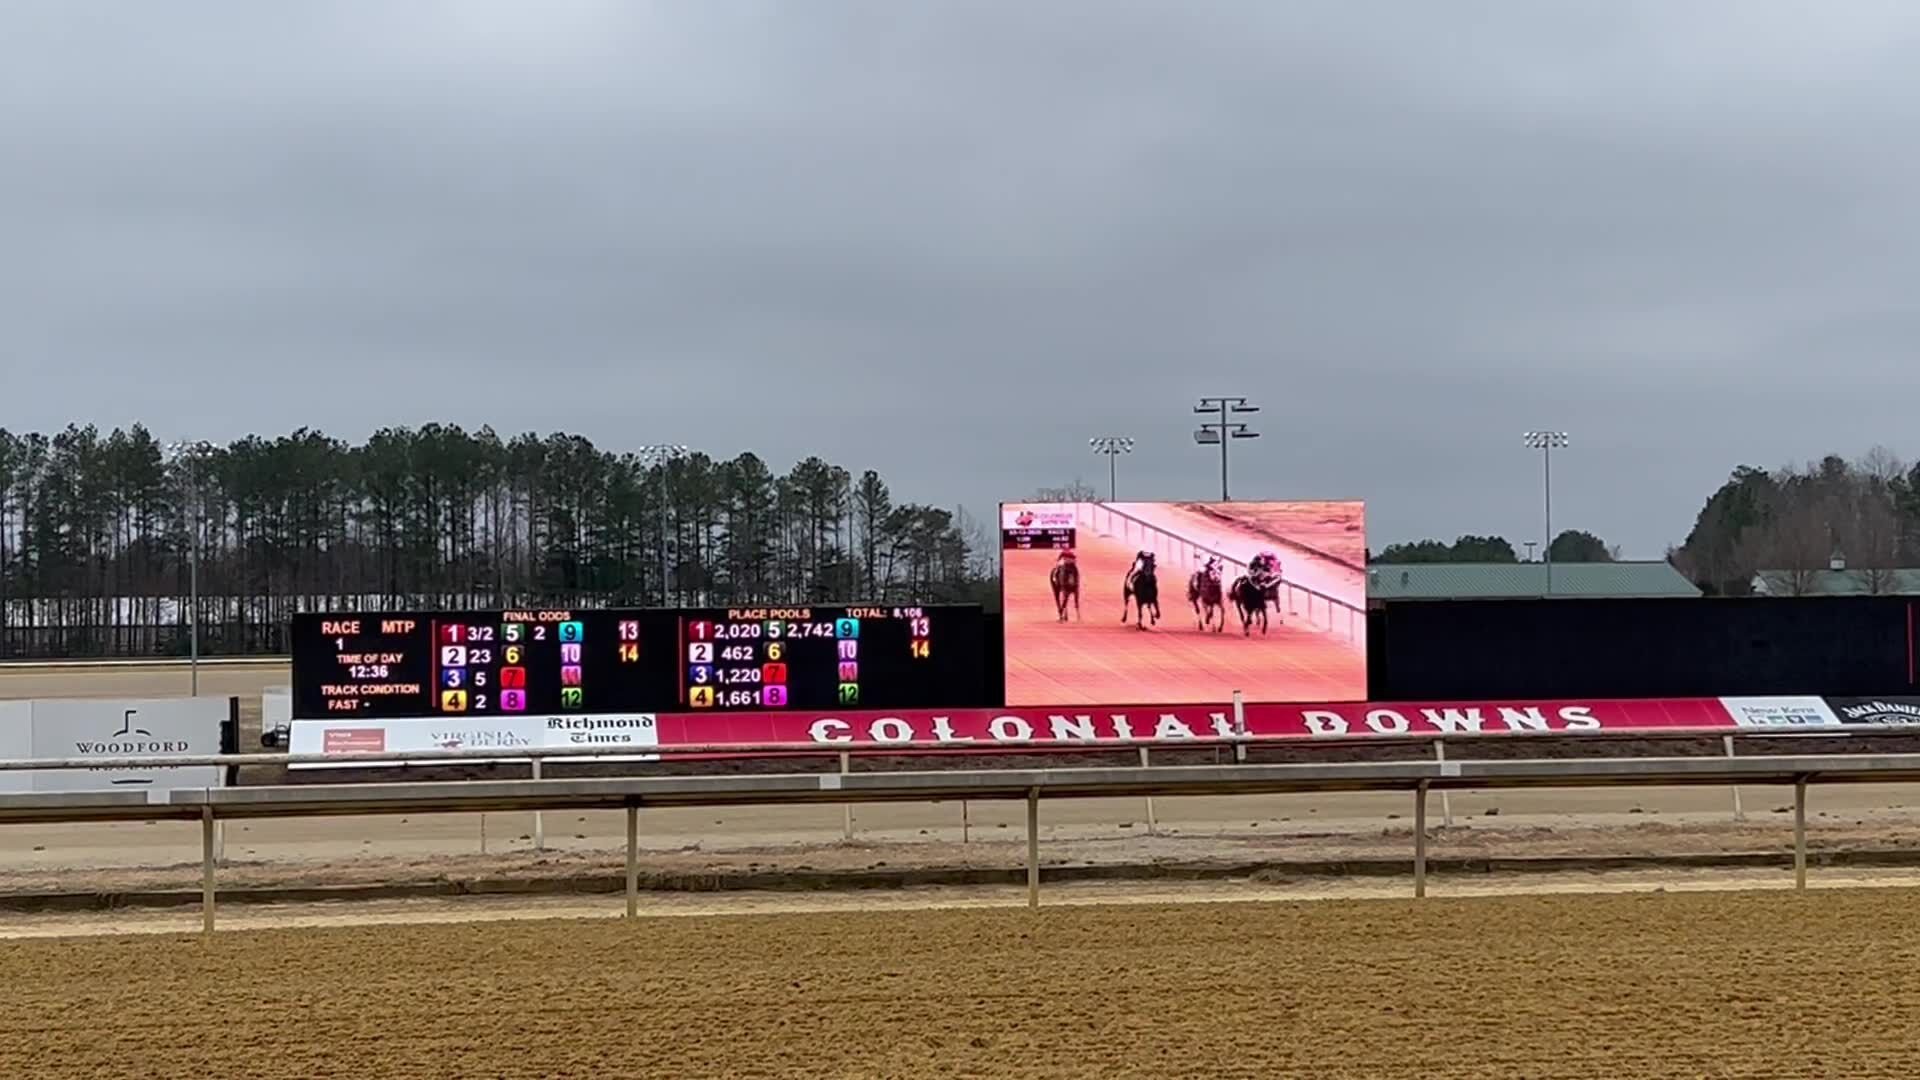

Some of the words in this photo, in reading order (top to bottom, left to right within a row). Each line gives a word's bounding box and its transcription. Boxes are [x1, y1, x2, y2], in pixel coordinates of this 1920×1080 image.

[503, 612, 536, 621] FINAL
[539, 611, 571, 621] ODDS
[728, 609, 767, 619] PLACE
[770, 608, 811, 619] POOLS
[846, 608, 887, 618] TOTAL:
[322, 621, 360, 634] RACE
[382, 620, 415, 633] MTP
[448, 625, 458, 642] 1
[468, 627, 494, 641] 3/2
[506, 624, 518, 641] 5
[534, 627, 546, 640] 2
[564, 624, 576, 641] 9
[619, 622, 639, 641] 13
[695, 622, 705, 639] 1
[714, 624, 760, 639] 2,020
[768, 622, 780, 638] 5
[787, 624, 834, 638] 2,742
[841, 620, 853, 636] 9
[910, 618, 930, 636] 13
[336, 638, 344, 650] 1
[768, 644, 780, 660] 6
[840, 641, 857, 659] 10
[911, 640, 930, 658] 14
[336, 654, 361, 664] TIME
[364, 654, 378, 663] OF
[381, 654, 403, 663] DAY
[448, 648, 459, 664] 2
[470, 650, 491, 663] 23
[506, 647, 519, 663] 6
[562, 645, 580, 662] 10
[619, 644, 639, 662] 14
[696, 644, 706, 661] 2
[721, 647, 753, 660] 462
[349, 665, 388, 678] 12:36
[448, 670, 460, 687] 3
[474, 672, 486, 686] 5
[506, 670, 518, 687] 7
[696, 667, 707, 683] 3
[716, 669, 760, 684] 1,220
[768, 666, 780, 681] 7
[321, 685, 358, 695] TRACK
[360, 684, 420, 694] CONDITION
[696, 689, 707, 705] 4
[716, 691, 760, 706] 1,661
[768, 688, 780, 704] 8
[840, 685, 858, 702] 12
[328, 700, 359, 710] FAST
[448, 692, 460, 709] 4
[475, 695, 486, 708] 2
[507, 692, 518, 708] 8
[562, 690, 582, 707] 12
[1841, 705, 1877, 718] JACK
[548, 717, 654, 730] Richmond
[808, 713, 1253, 742] COLONIAL
[1301, 707, 1602, 735] DOWNS
[431, 730, 516, 741] VIRGINIA
[570, 732, 632, 744] Times
[76, 741, 188, 754] WOODFORD
